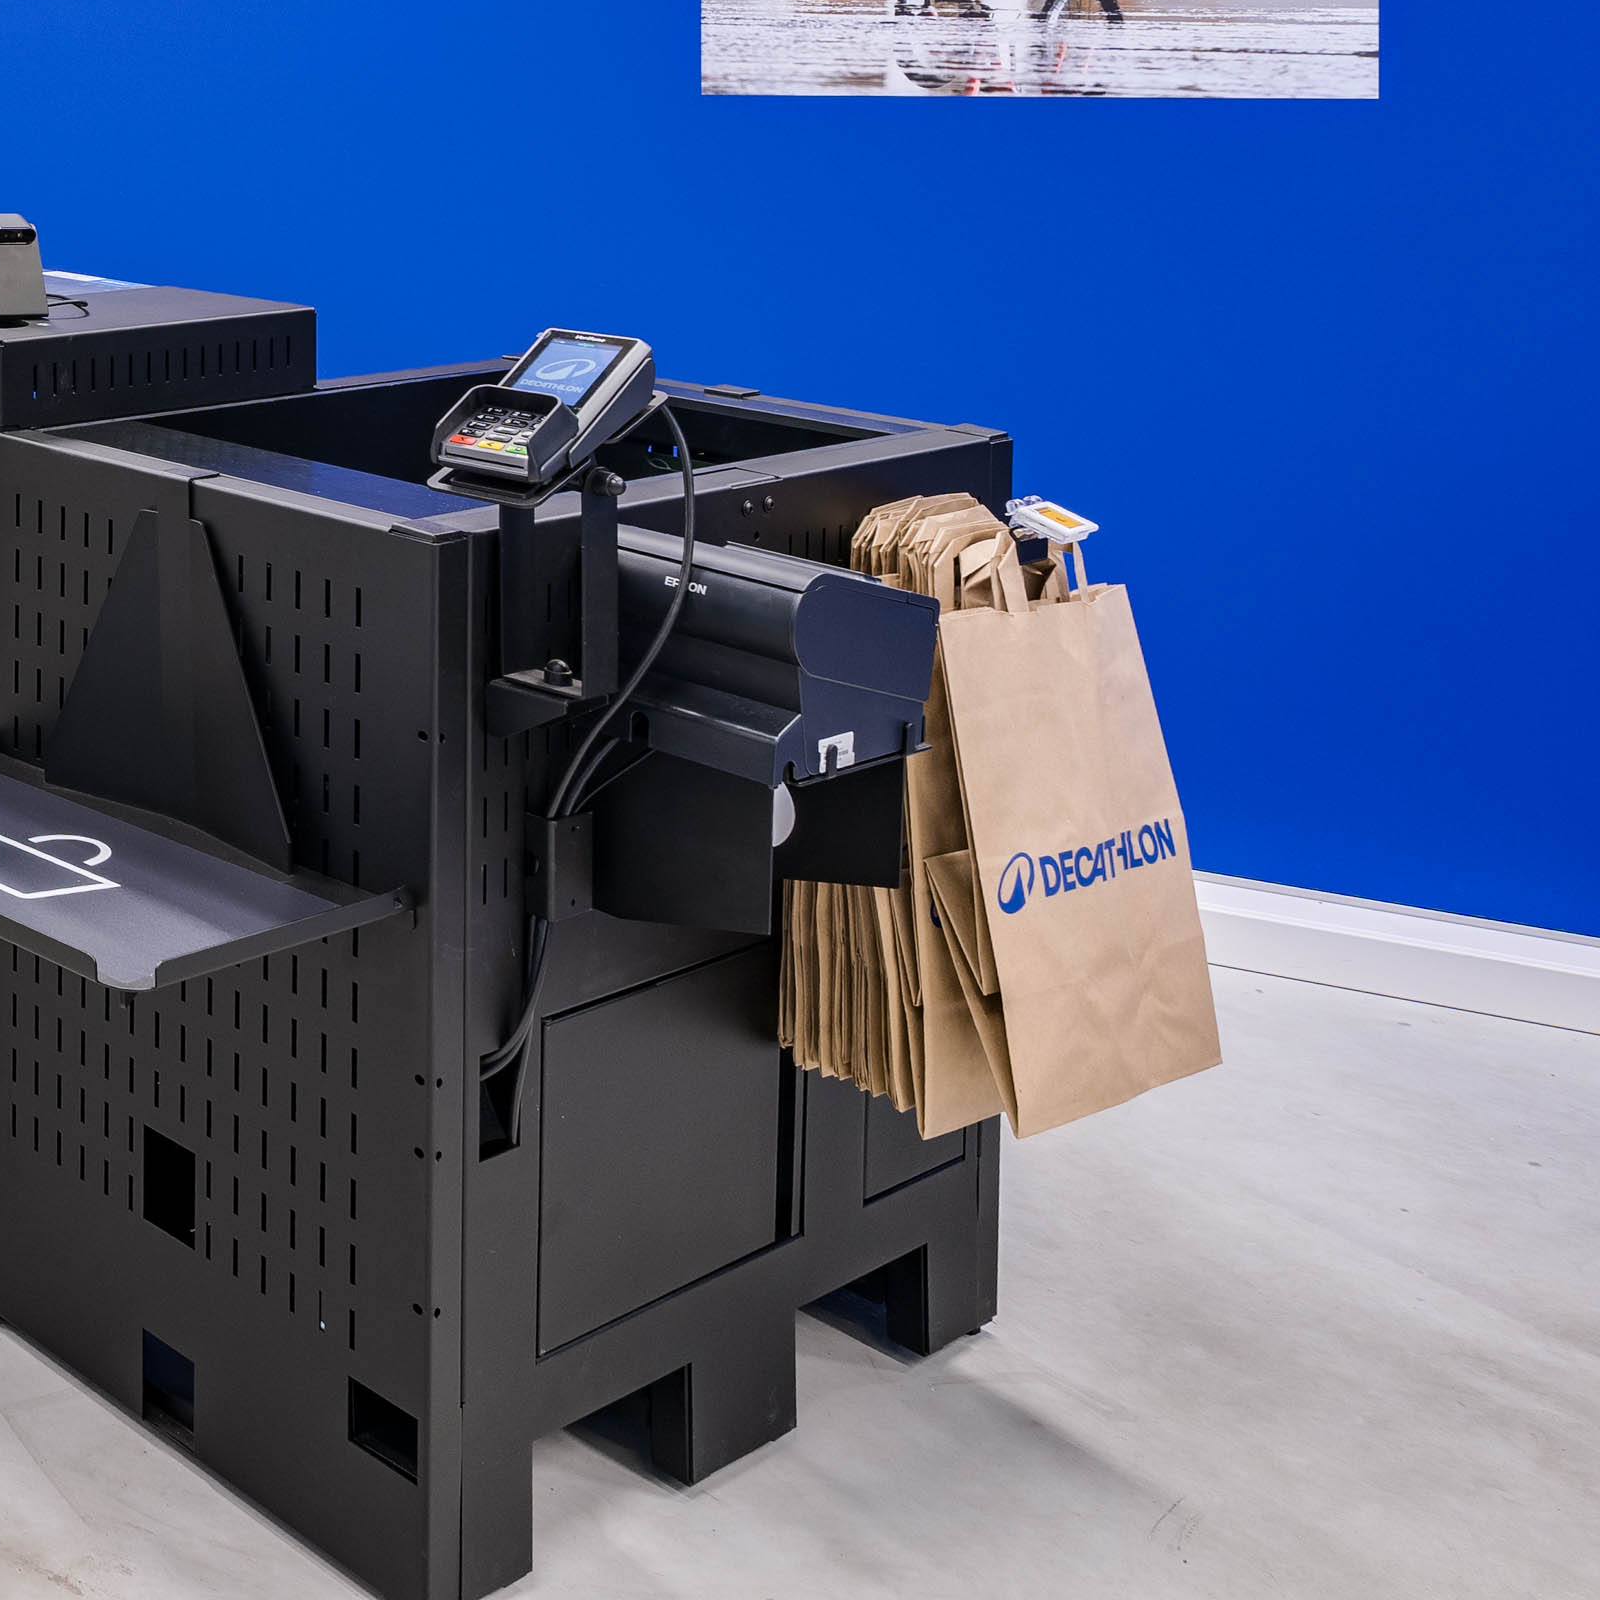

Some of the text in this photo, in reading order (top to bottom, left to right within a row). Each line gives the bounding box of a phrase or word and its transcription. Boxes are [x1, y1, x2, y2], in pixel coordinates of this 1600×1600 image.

[519, 378, 585, 394] DECATHLON
[664, 575, 708, 596] EPON
[1038, 818, 1177, 898] DECATHLON
